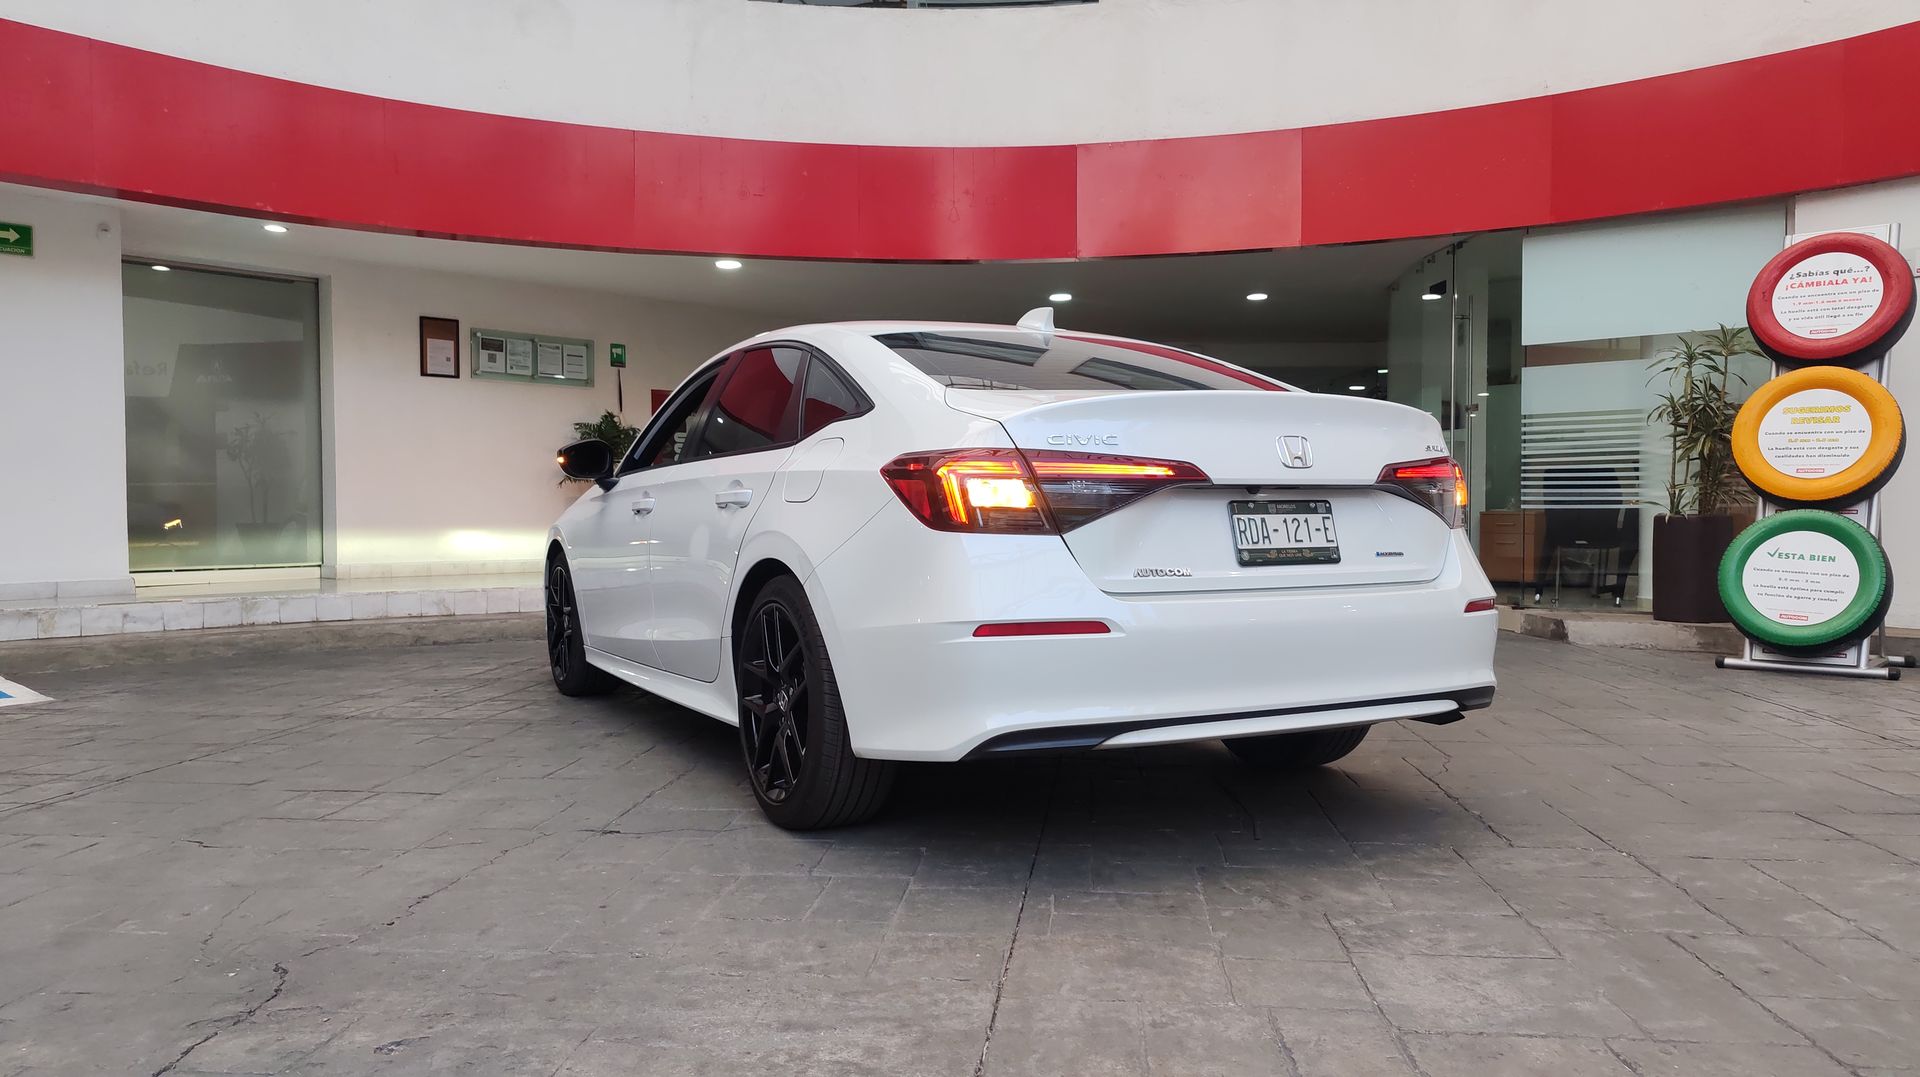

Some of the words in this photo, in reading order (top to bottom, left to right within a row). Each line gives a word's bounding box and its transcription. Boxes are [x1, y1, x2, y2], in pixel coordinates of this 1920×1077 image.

[1790, 269, 1829, 280] ¿Sabías
[1785, 278, 1849, 291] ¡CÁMBIALA
[1852, 276, 1872, 284] YA!
[1791, 416, 1840, 424] REVISAR
[1047, 434, 1119, 446] CIVIC
[1237, 516, 1335, 545] RDA-121-E
[1777, 552, 1805, 560] ESTA
[1809, 554, 1836, 562] BIEN
[1133, 568, 1192, 577] AUTOCOM
